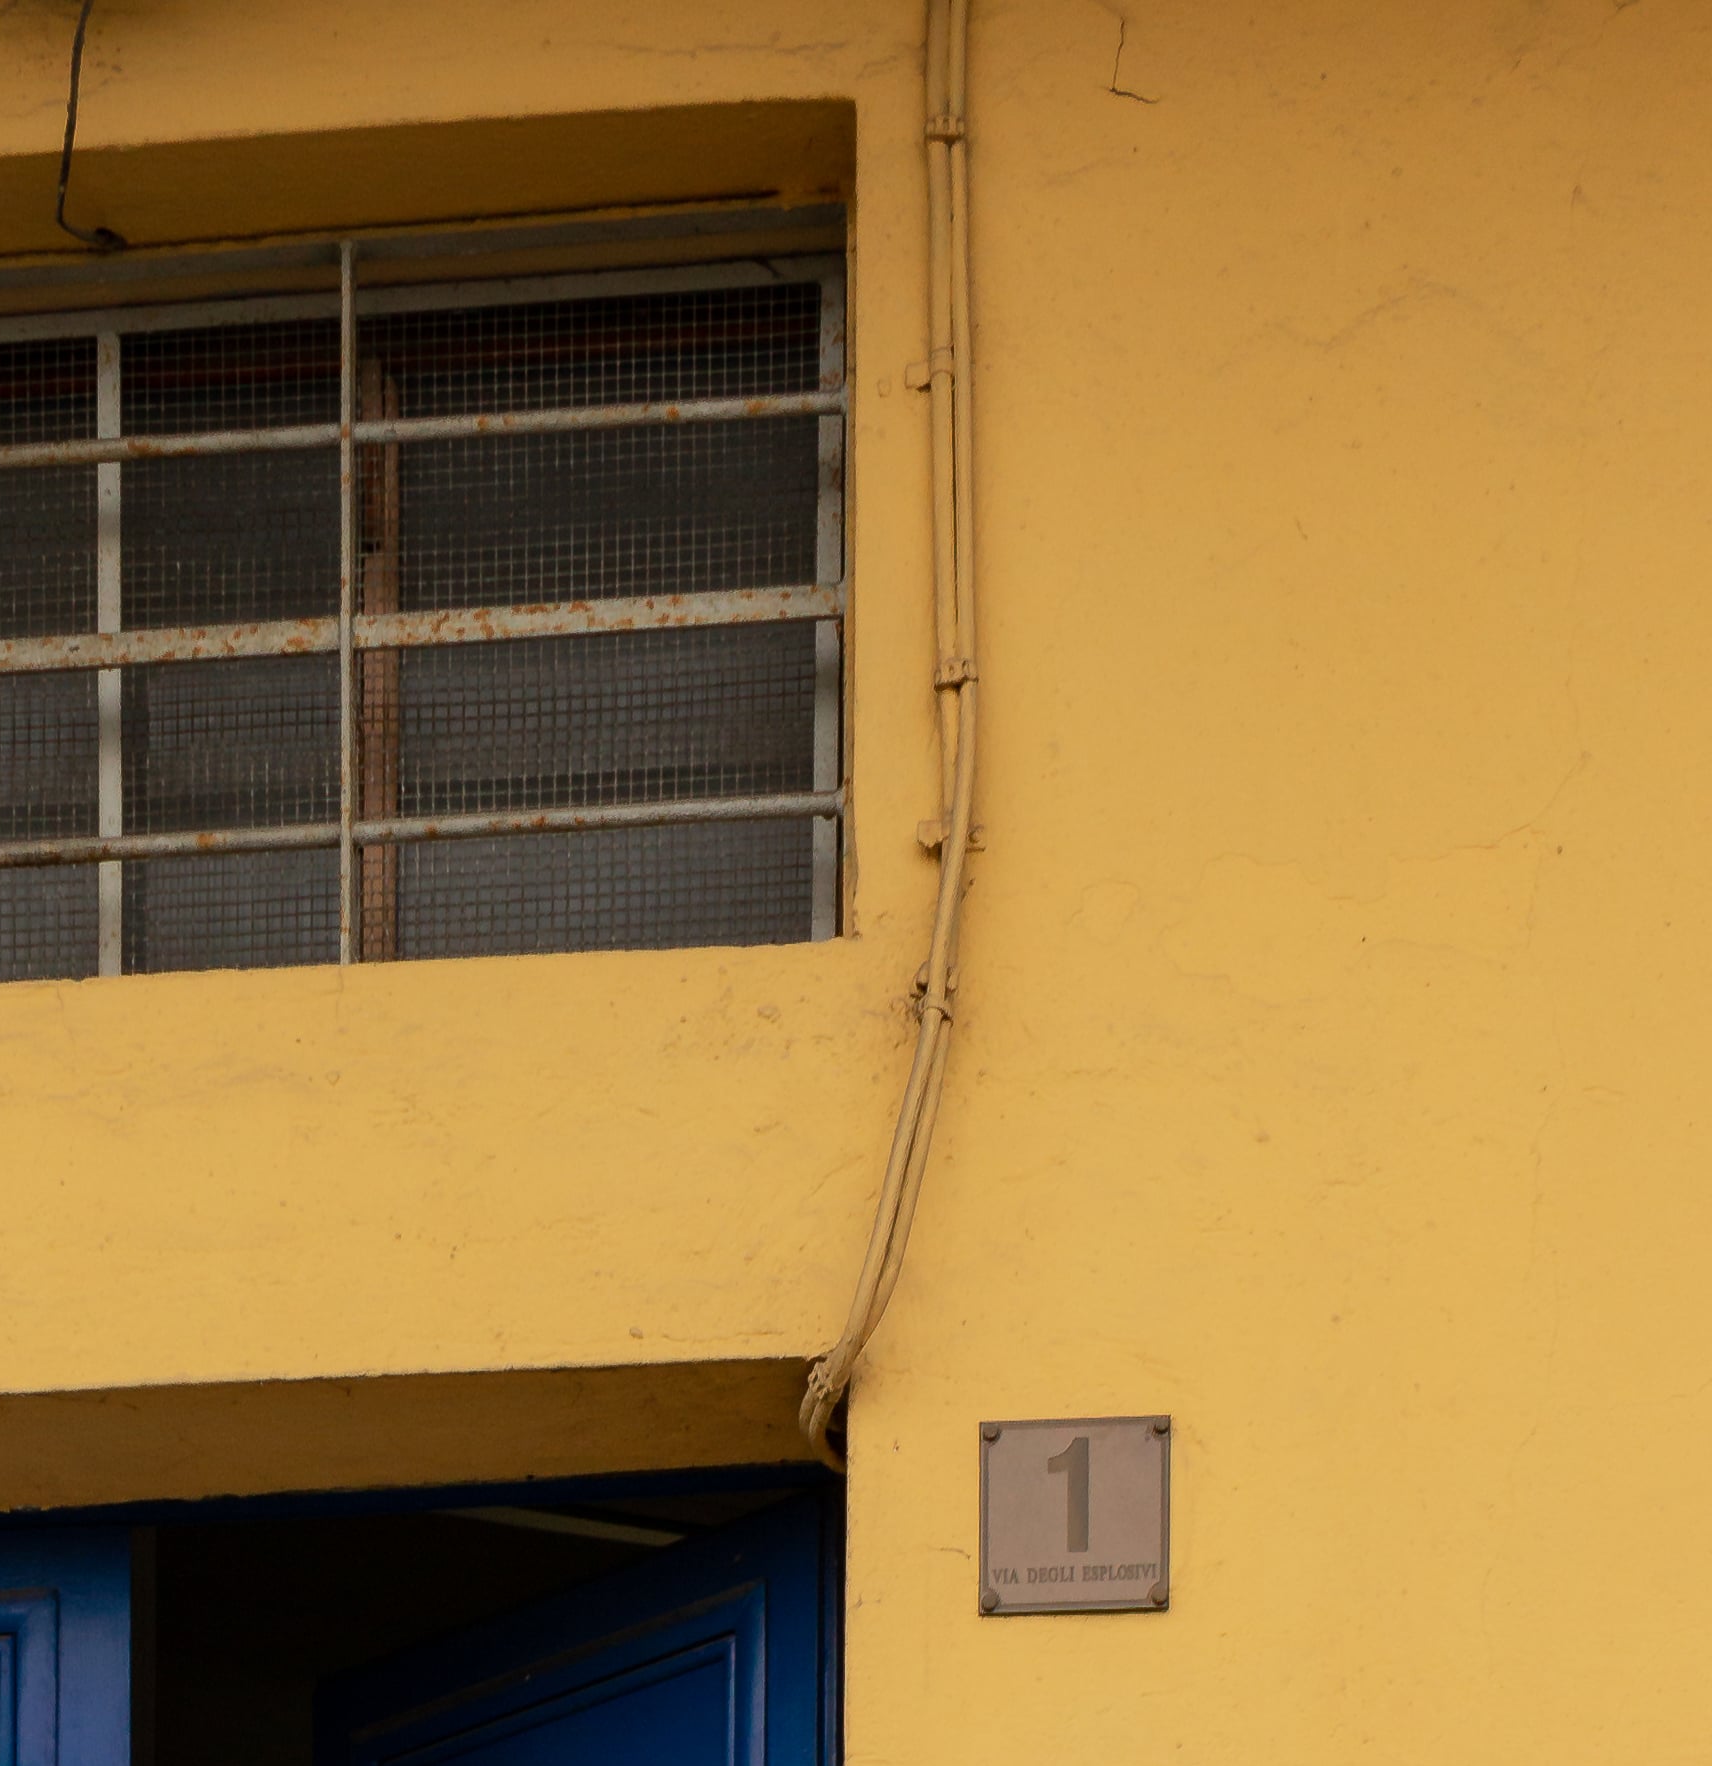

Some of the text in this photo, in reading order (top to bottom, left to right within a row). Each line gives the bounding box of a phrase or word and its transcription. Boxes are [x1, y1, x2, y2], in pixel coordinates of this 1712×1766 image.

[1047, 1436, 1089, 1553] 1
[992, 1563, 1157, 1585] VIA DEGLI ESPLOSIVI
